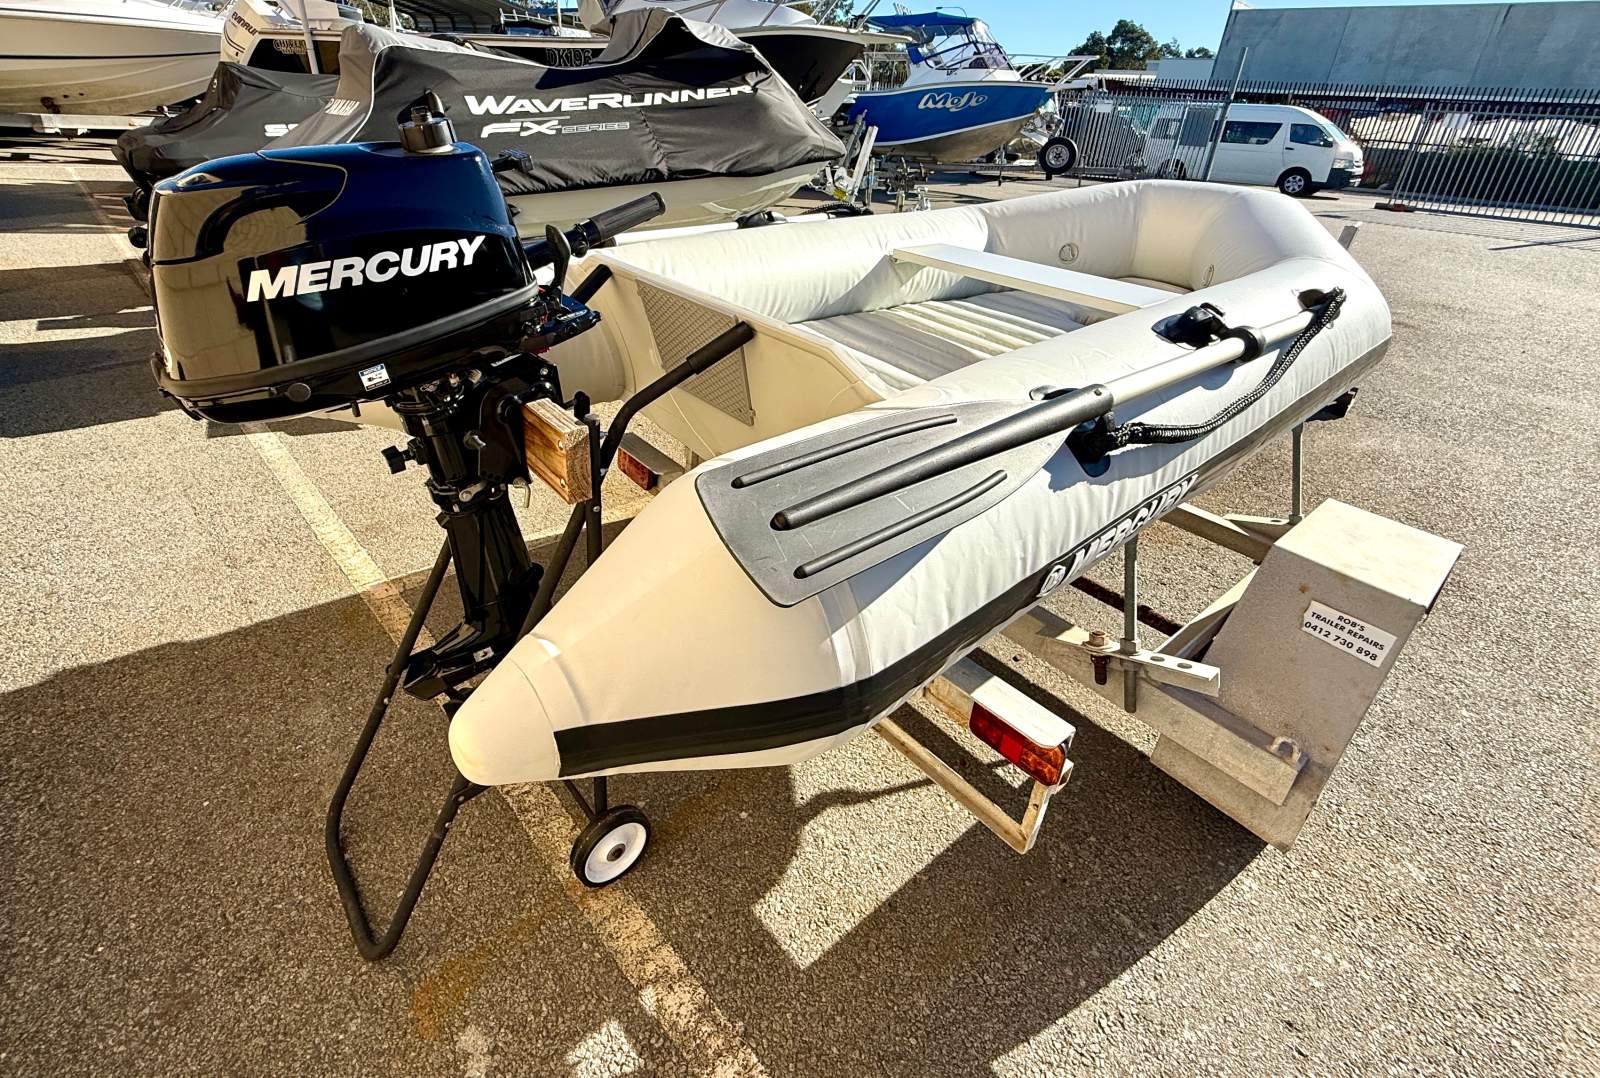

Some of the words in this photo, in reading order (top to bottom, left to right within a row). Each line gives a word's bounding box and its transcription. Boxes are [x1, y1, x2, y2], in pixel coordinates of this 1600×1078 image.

[246, 234, 486, 303] MERCURY
[1063, 473, 1199, 585] MERCURY
[1304, 621, 1332, 638] 0412
[1332, 634, 1354, 649] 730
[1356, 646, 1378, 661] 898
[1310, 611, 1346, 632] TRAILER
[1346, 628, 1385, 651] REPAIRS
[1337, 614, 1366, 632] ROB'S
